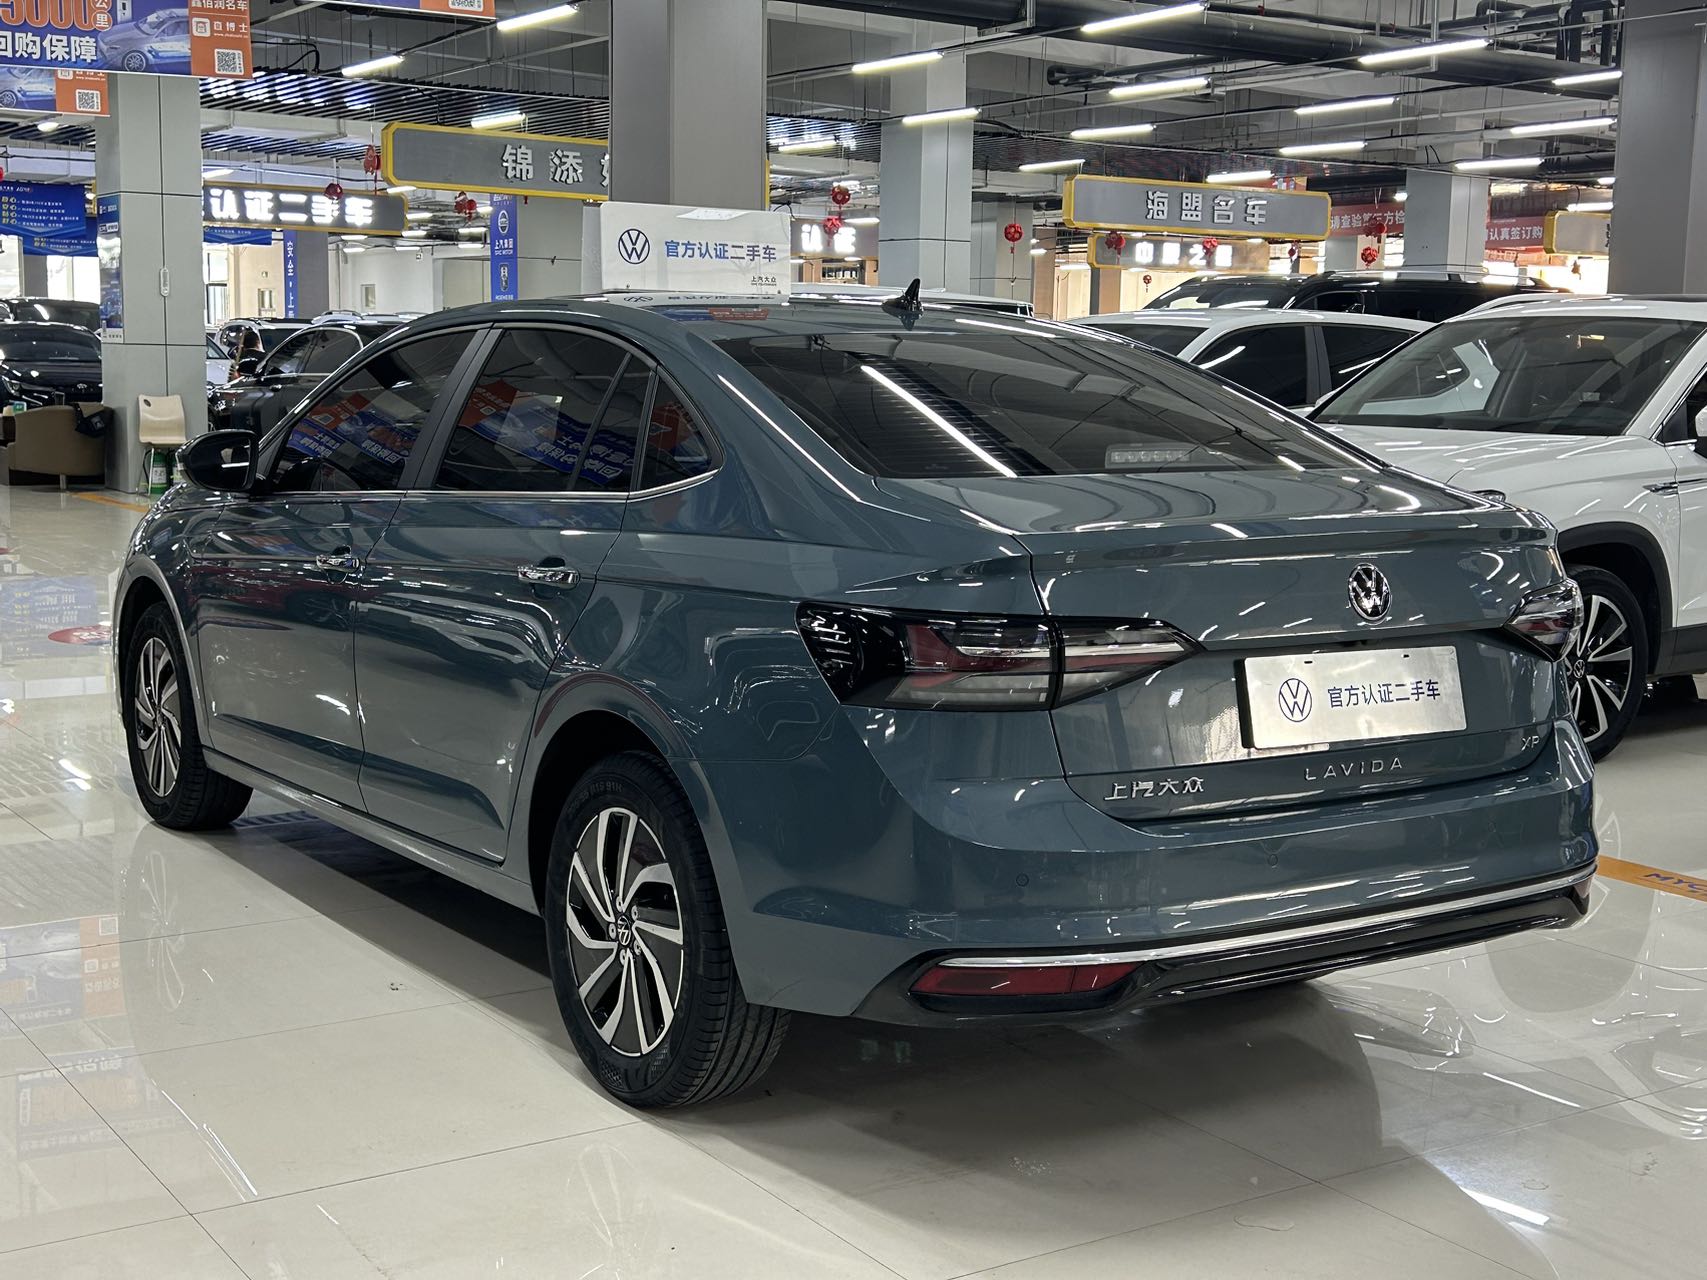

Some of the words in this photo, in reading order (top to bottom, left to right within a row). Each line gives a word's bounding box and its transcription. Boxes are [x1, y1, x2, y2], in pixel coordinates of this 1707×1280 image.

[202, 188, 373, 227] 认证二手车
[1146, 190, 1268, 225] 海盟名车
[1485, 225, 1543, 241] 认真签订购
[664, 240, 777, 263] 官方认证二手车
[751, 275, 777, 283] 上汽大众
[1326, 678, 1442, 709] 官方认证二手车
[1520, 735, 1540, 751] XP
[1304, 757, 1402, 781] LAVIDA
[1104, 776, 1204, 801] 上汽大众
